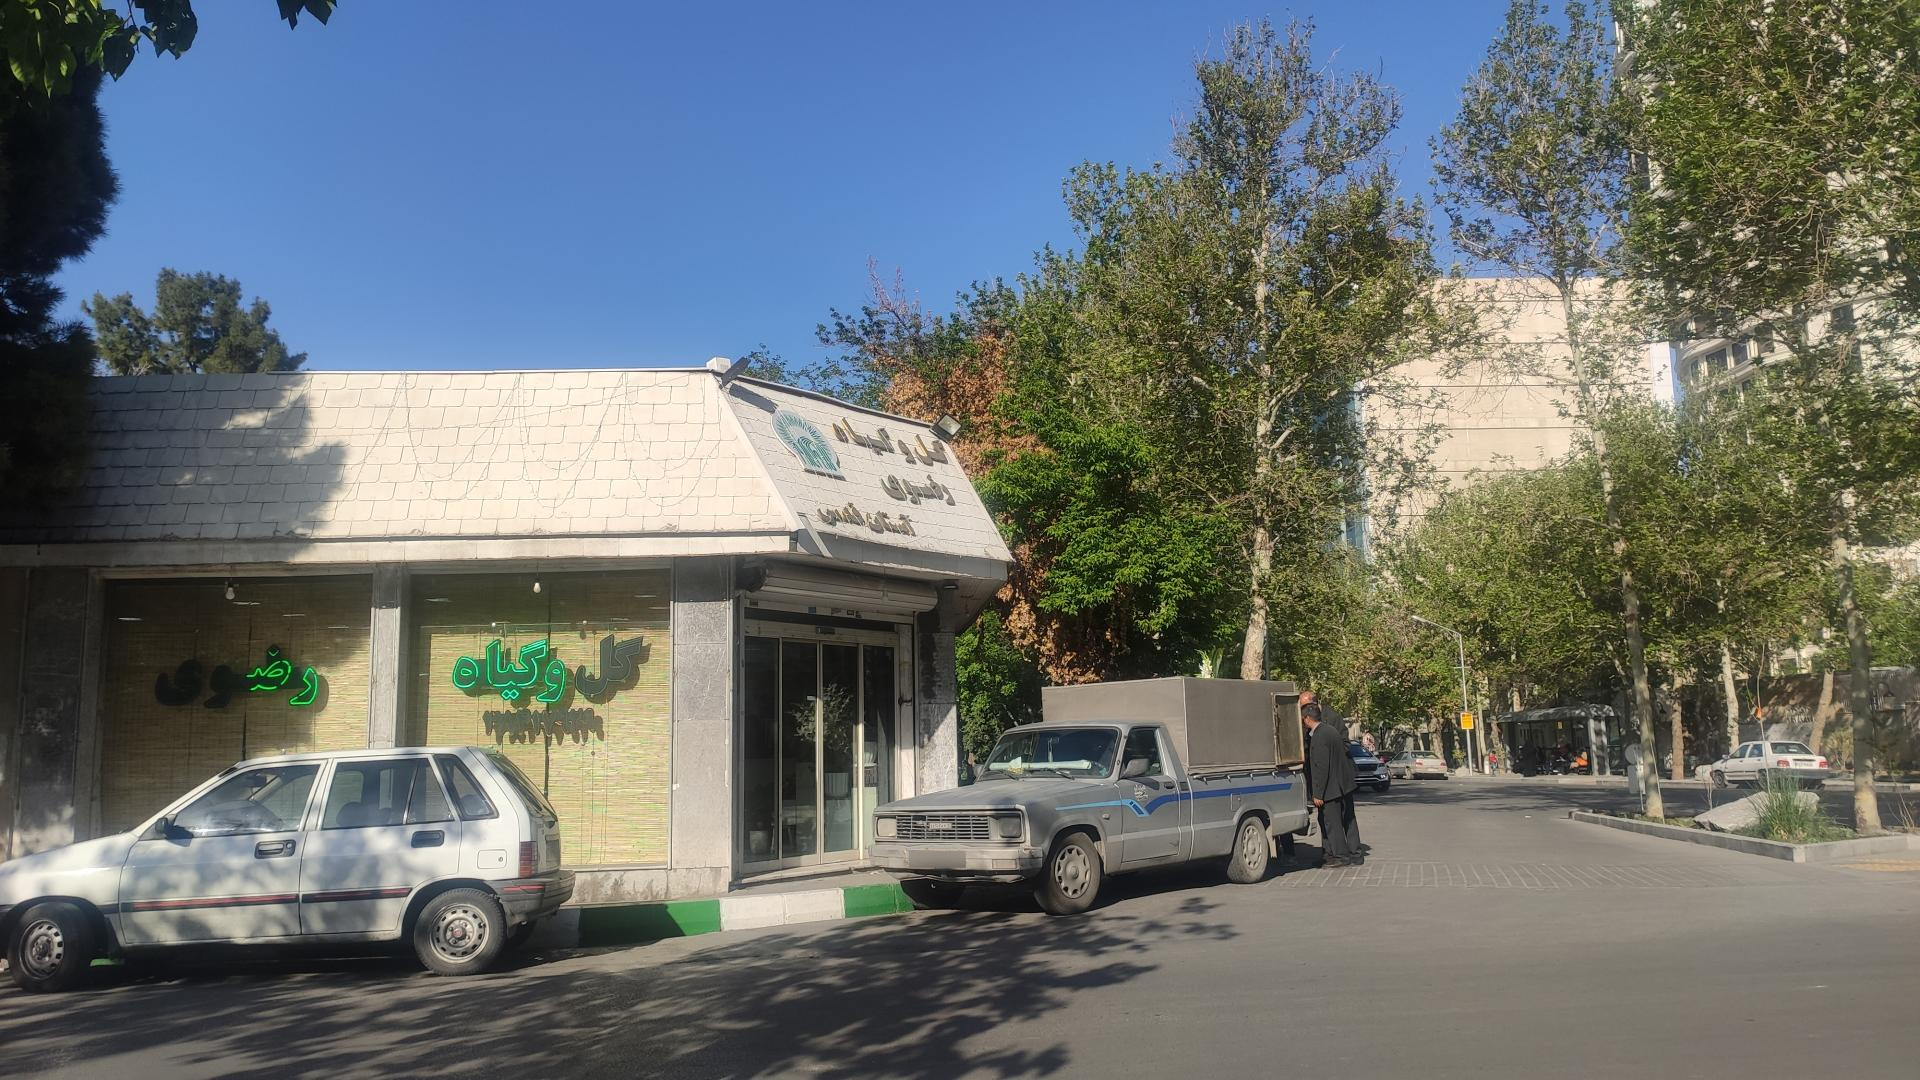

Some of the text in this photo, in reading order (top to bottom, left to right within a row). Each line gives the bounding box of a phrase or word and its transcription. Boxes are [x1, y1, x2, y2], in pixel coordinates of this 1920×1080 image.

[881, 474, 957, 507] رضوی
[155, 644, 319, 708] رضوی
[453, 638, 549, 700] گیاه
[574, 634, 644, 696] گل
